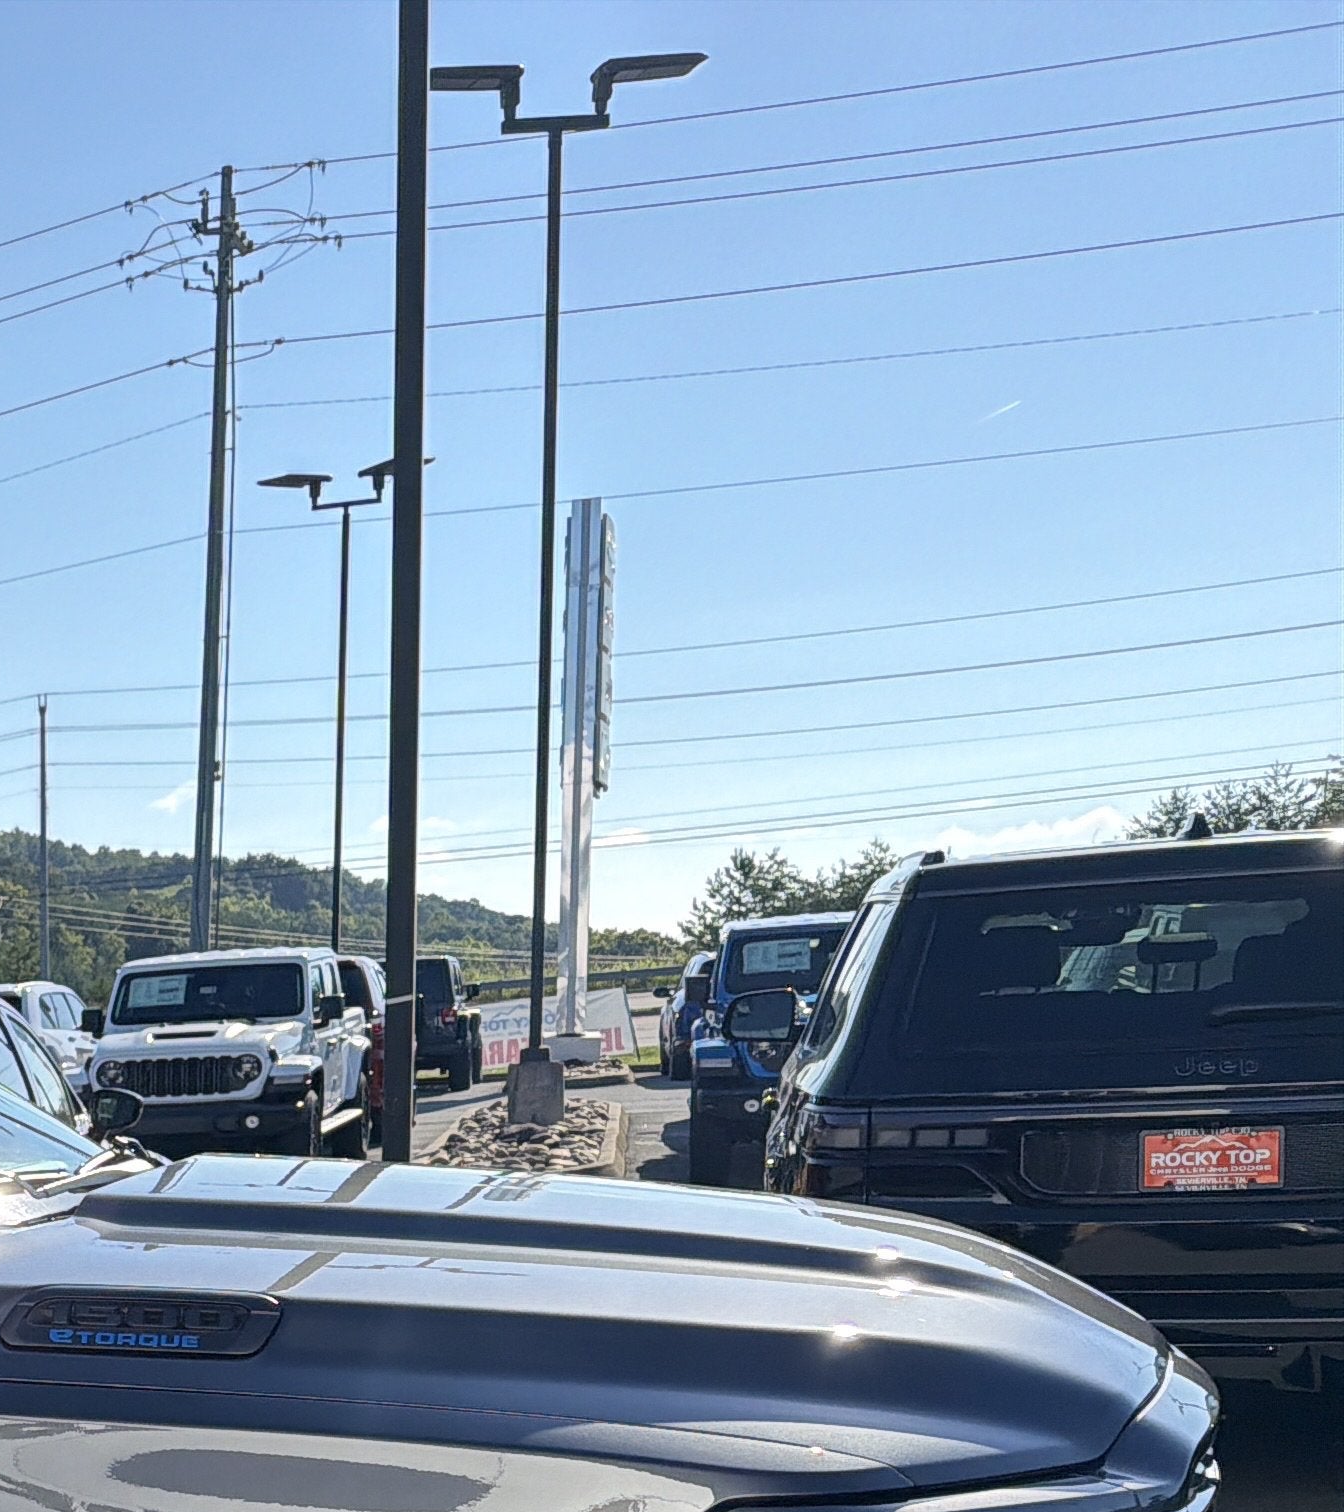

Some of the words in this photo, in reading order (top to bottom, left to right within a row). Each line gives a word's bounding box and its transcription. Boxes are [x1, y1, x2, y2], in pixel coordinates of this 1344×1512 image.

[1174, 1056, 1259, 1077] Jeep
[1150, 1150, 1222, 1168] ROCKY
[1225, 1149, 1272, 1165] TOP
[1149, 1167, 1206, 1175] CHRYSLER
[1230, 1164, 1272, 1173] DODGE
[28, 1300, 248, 1331] 1500
[49, 1328, 201, 1349] eTORQUE
